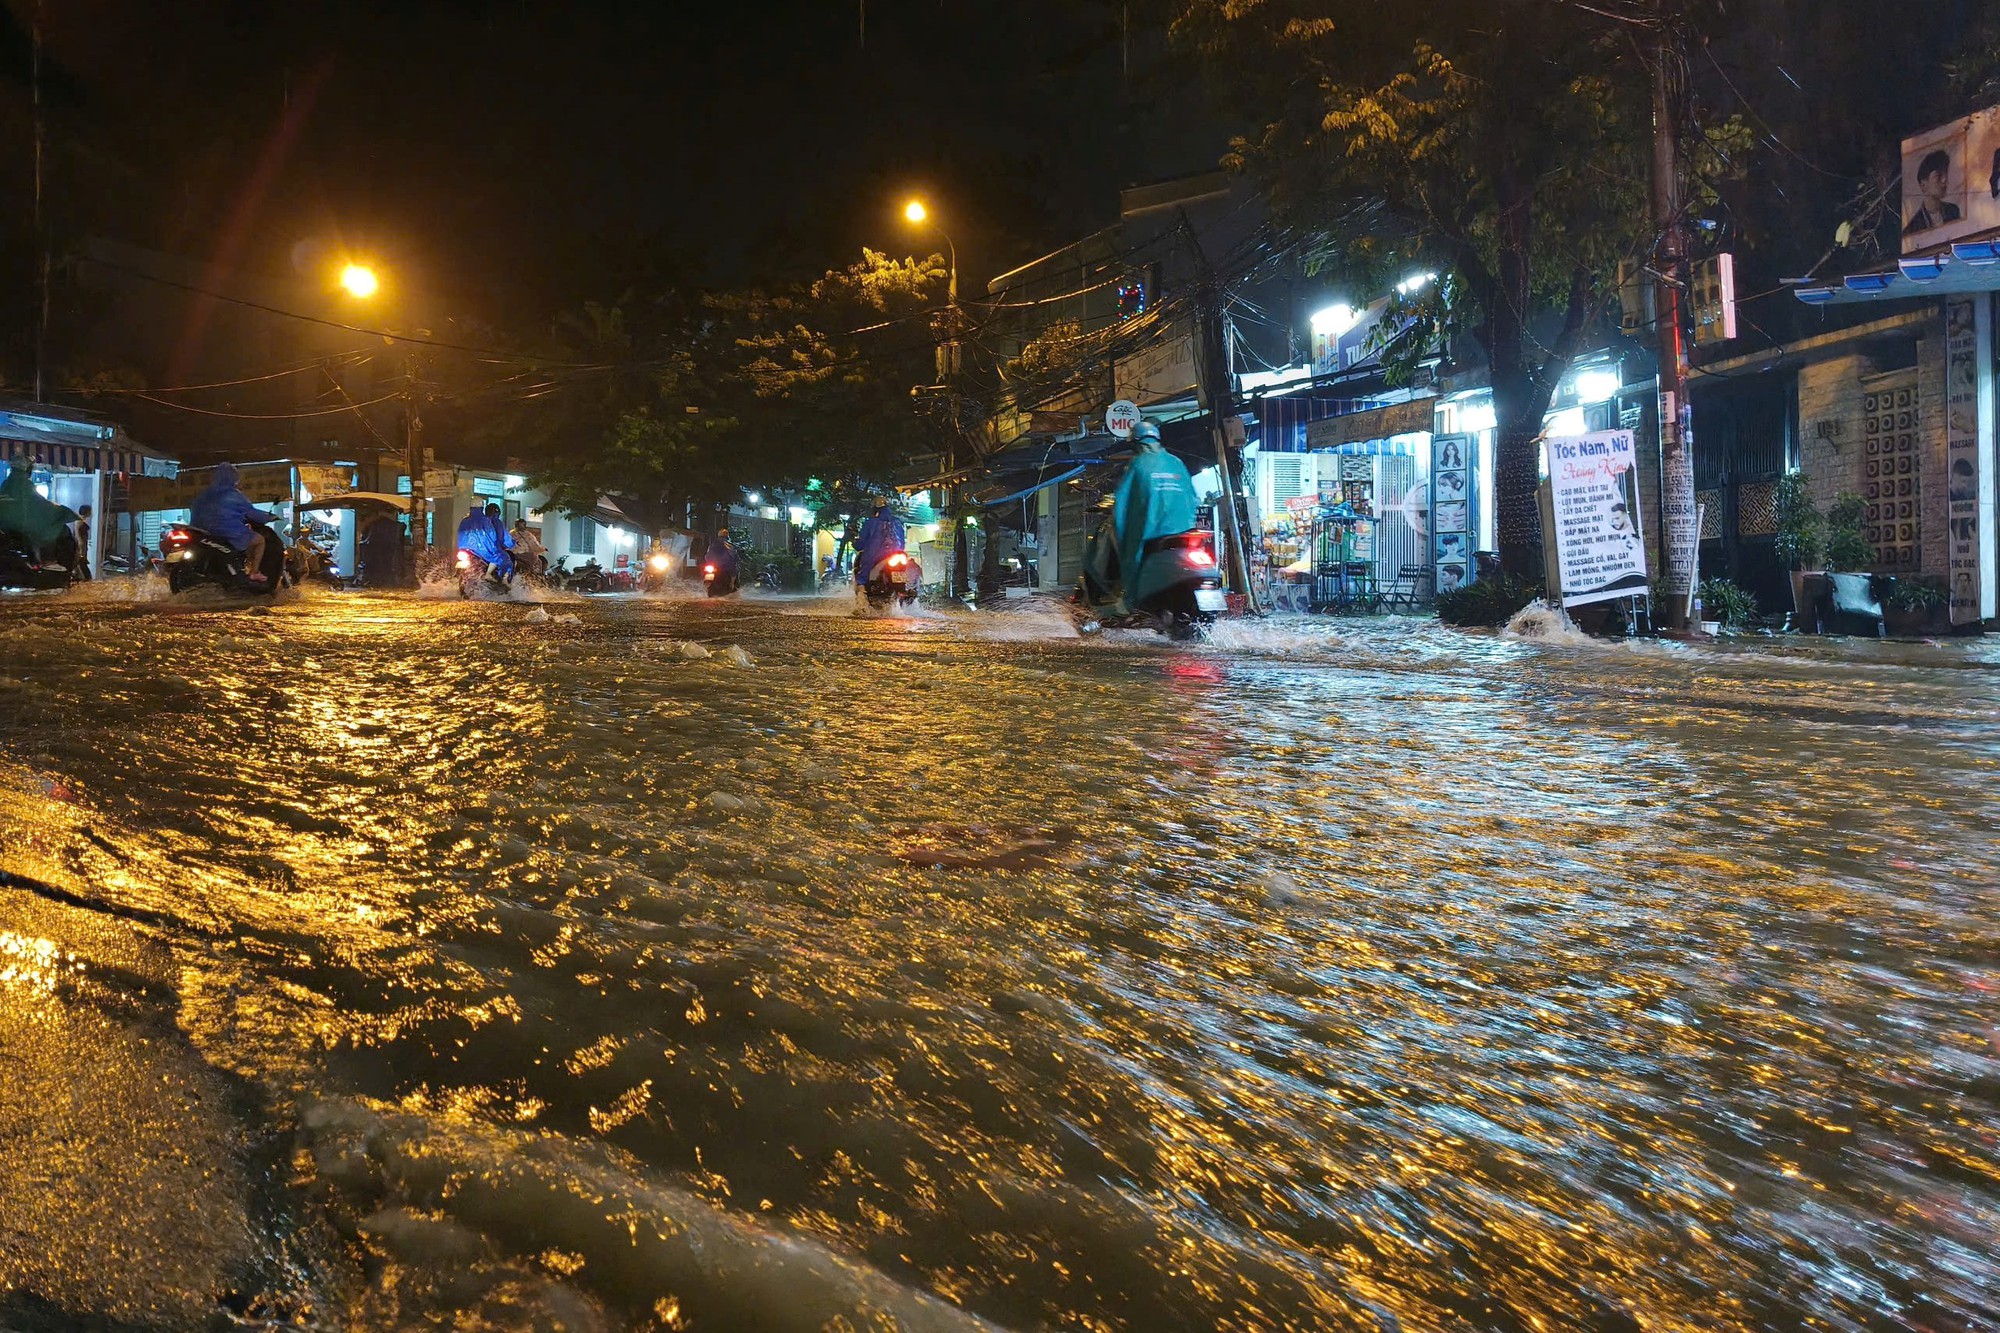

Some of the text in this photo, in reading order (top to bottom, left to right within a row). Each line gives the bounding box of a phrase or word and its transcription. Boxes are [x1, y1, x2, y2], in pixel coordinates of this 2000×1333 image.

[1554, 435, 1629, 459] Tóc Nam, Nữ
[1563, 517, 1590, 526] MASSAGE
[1567, 556, 1594, 567] MASSAGE
